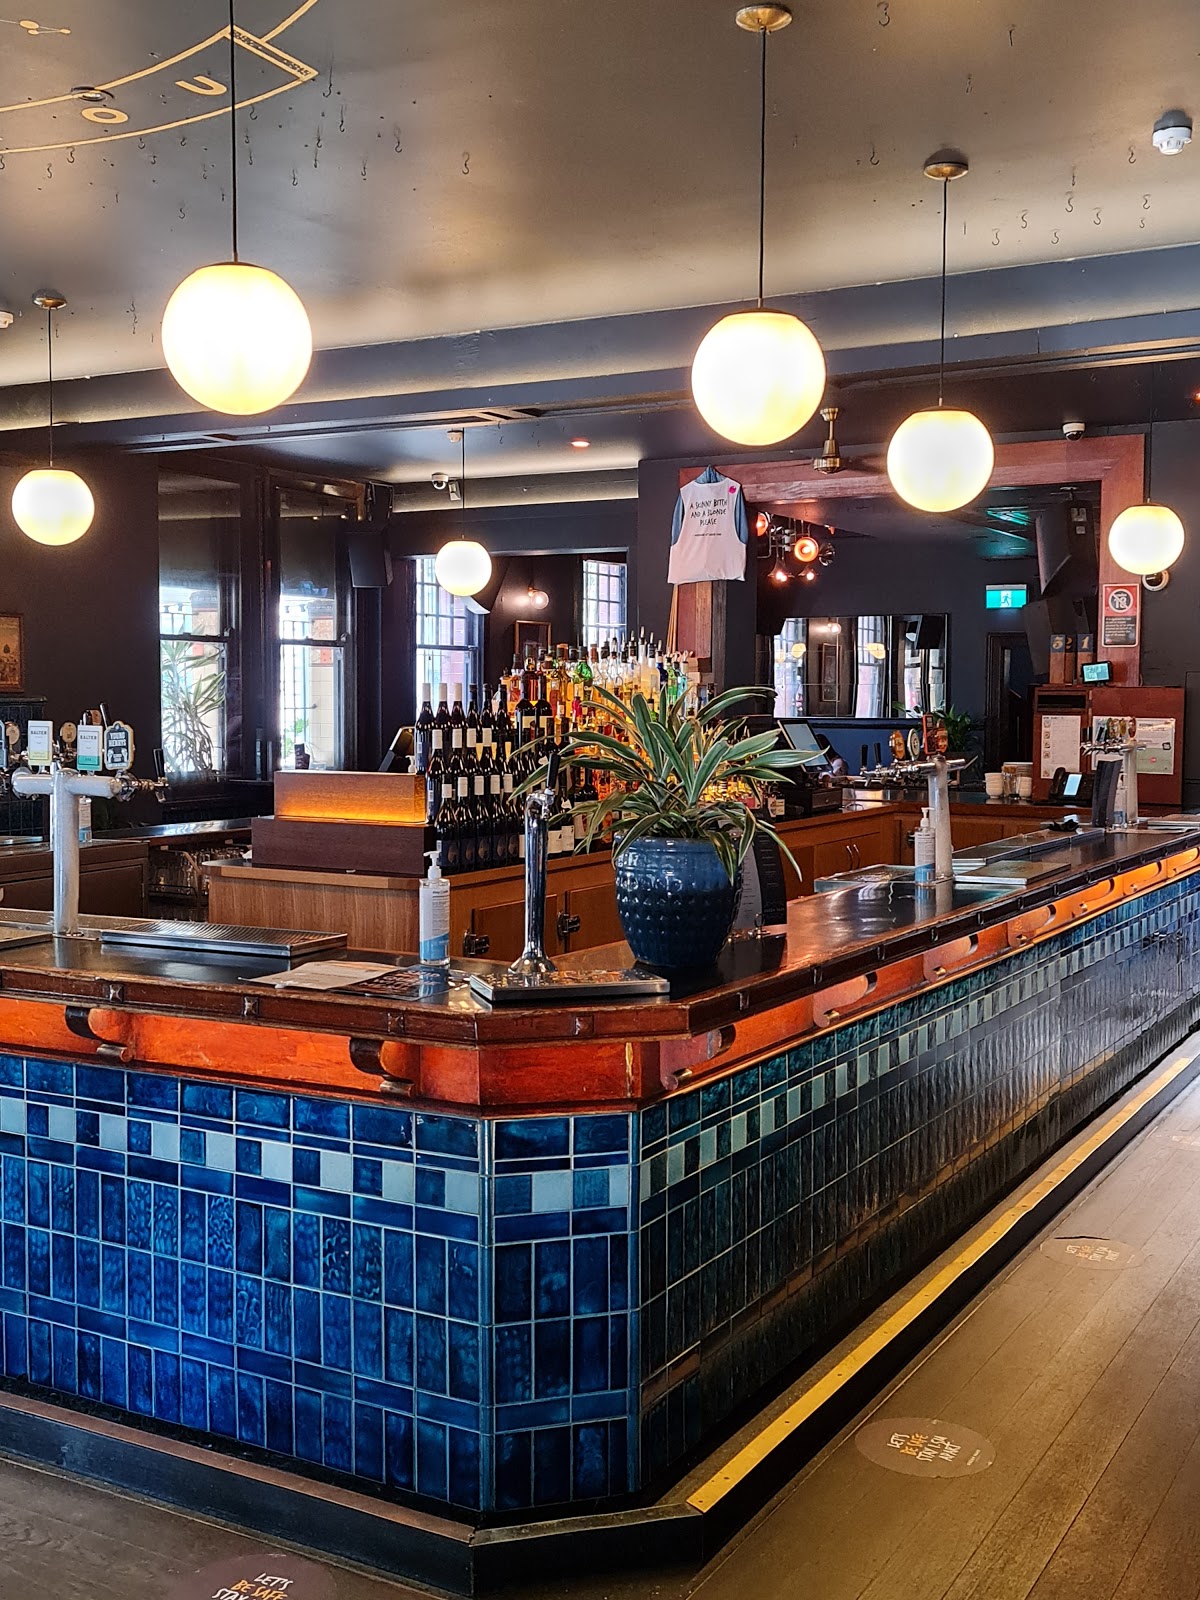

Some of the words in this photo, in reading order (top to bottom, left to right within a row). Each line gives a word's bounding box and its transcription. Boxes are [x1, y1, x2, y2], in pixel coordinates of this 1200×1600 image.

[700, 518, 716, 526] PLEASE
[1081, 636, 1089, 649] 1
[887, 1432, 910, 1449] LET'S
[230, 1579, 256, 1593] BE
[250, 1585, 288, 1600] SAFE
[253, 1572, 294, 1591] LET'S
